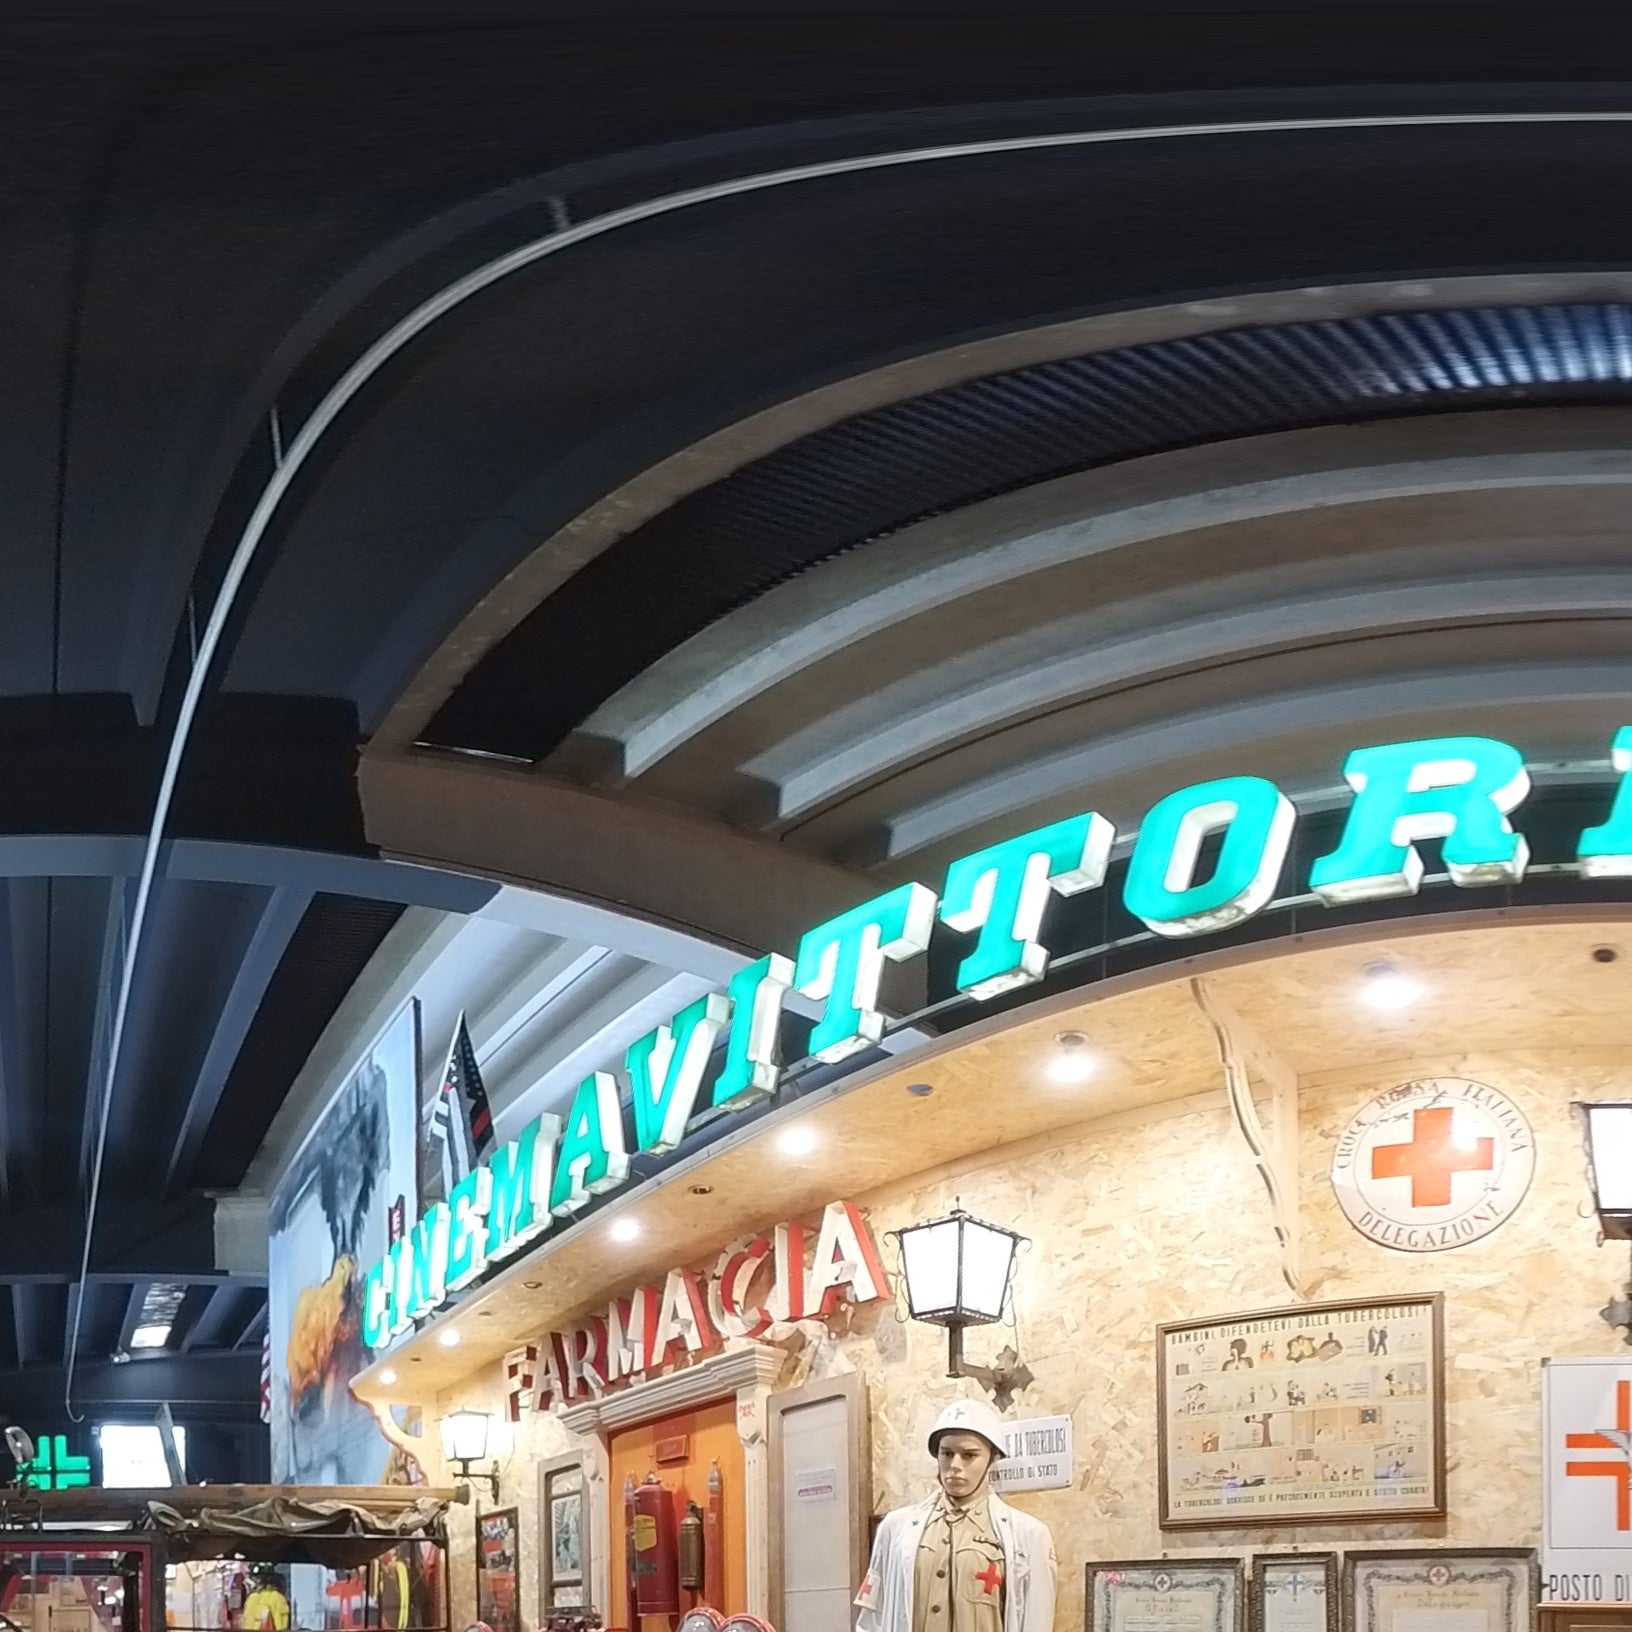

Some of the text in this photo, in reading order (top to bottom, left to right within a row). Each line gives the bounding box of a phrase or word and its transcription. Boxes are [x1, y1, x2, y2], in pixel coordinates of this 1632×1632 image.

[1357, 1200, 1505, 1249] DELEGAZIONE
[502, 1200, 890, 1423] FARMACIA
[1297, 1314, 1331, 1329] DALLA
[1038, 1464, 1058, 1477] STATO
[1549, 1574, 1603, 1601] POSTO
[1615, 1574, 1631, 1601] DI
